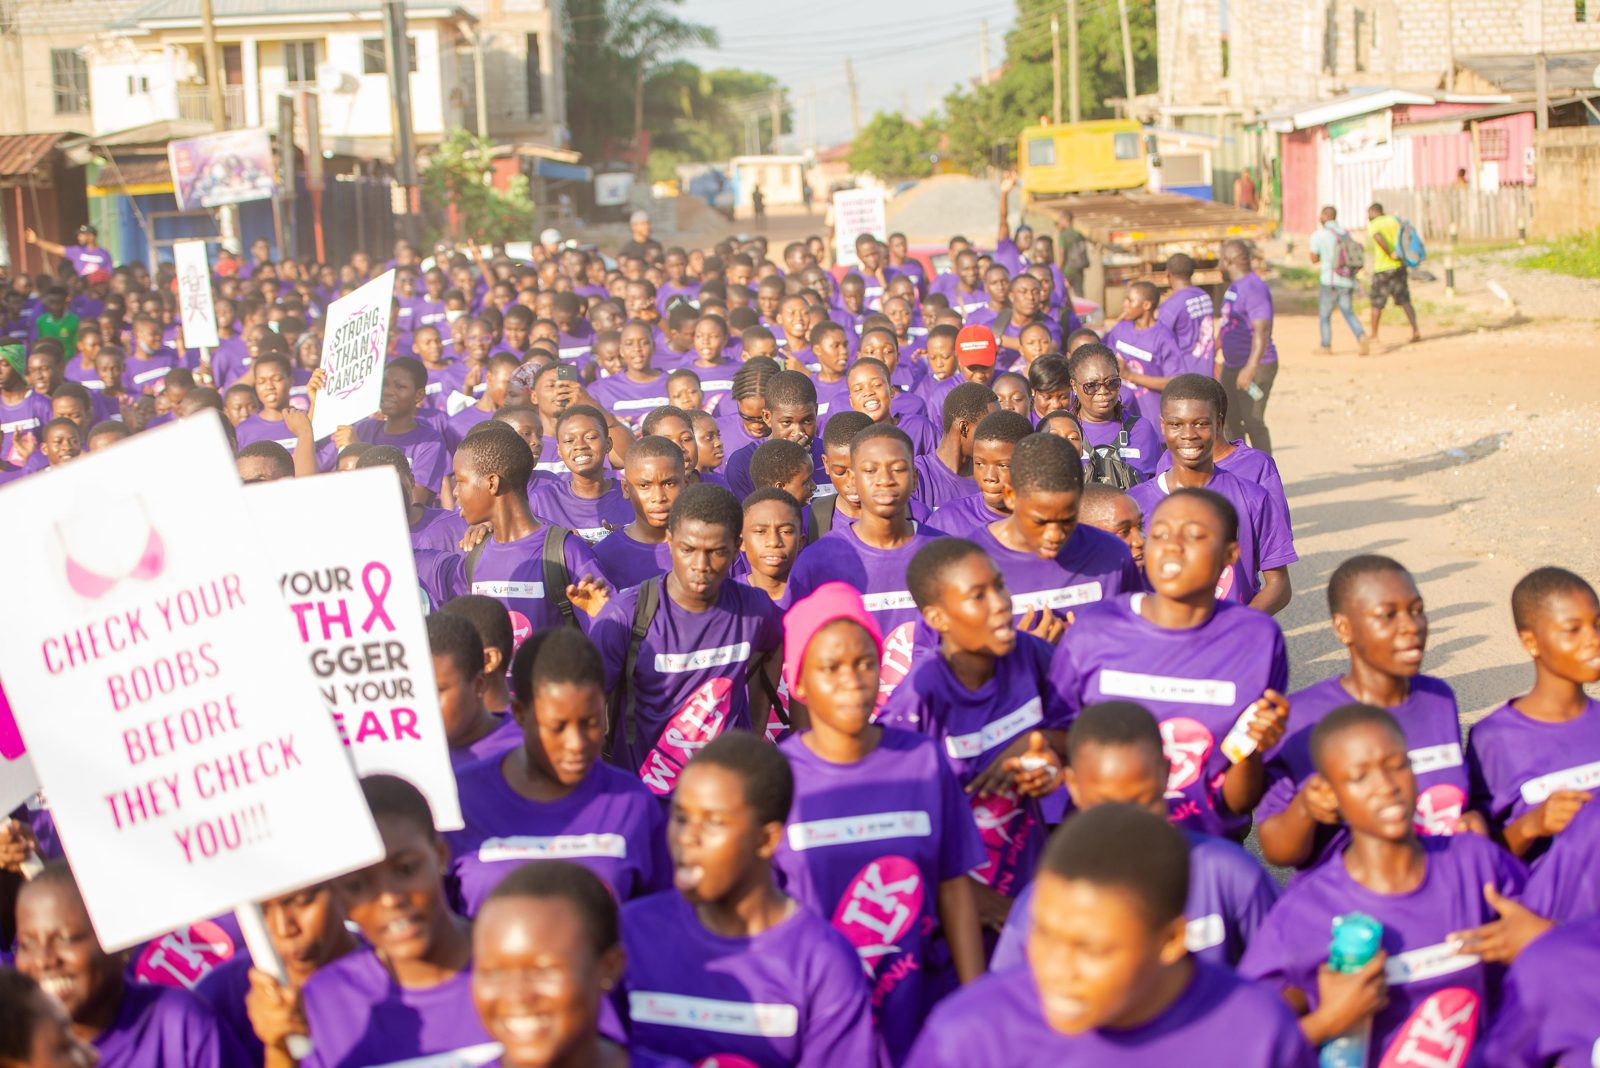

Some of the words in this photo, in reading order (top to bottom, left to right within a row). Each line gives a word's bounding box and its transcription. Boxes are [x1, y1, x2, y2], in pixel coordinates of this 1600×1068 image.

[334, 308, 379, 347] STRONG
[335, 333, 369, 371] THAN
[326, 355, 373, 395] CANCER
[41, 608, 150, 675] CHECK
[156, 574, 245, 633] YOUR
[107, 643, 220, 713] BOOBS
[309, 641, 409, 678] GGER
[345, 678, 415, 703] YOUR
[121, 694, 242, 766] BEFORE
[104, 774, 184, 831] THEY
[193, 734, 302, 801] CHECK
[174, 803, 273, 864] YOU!!!
